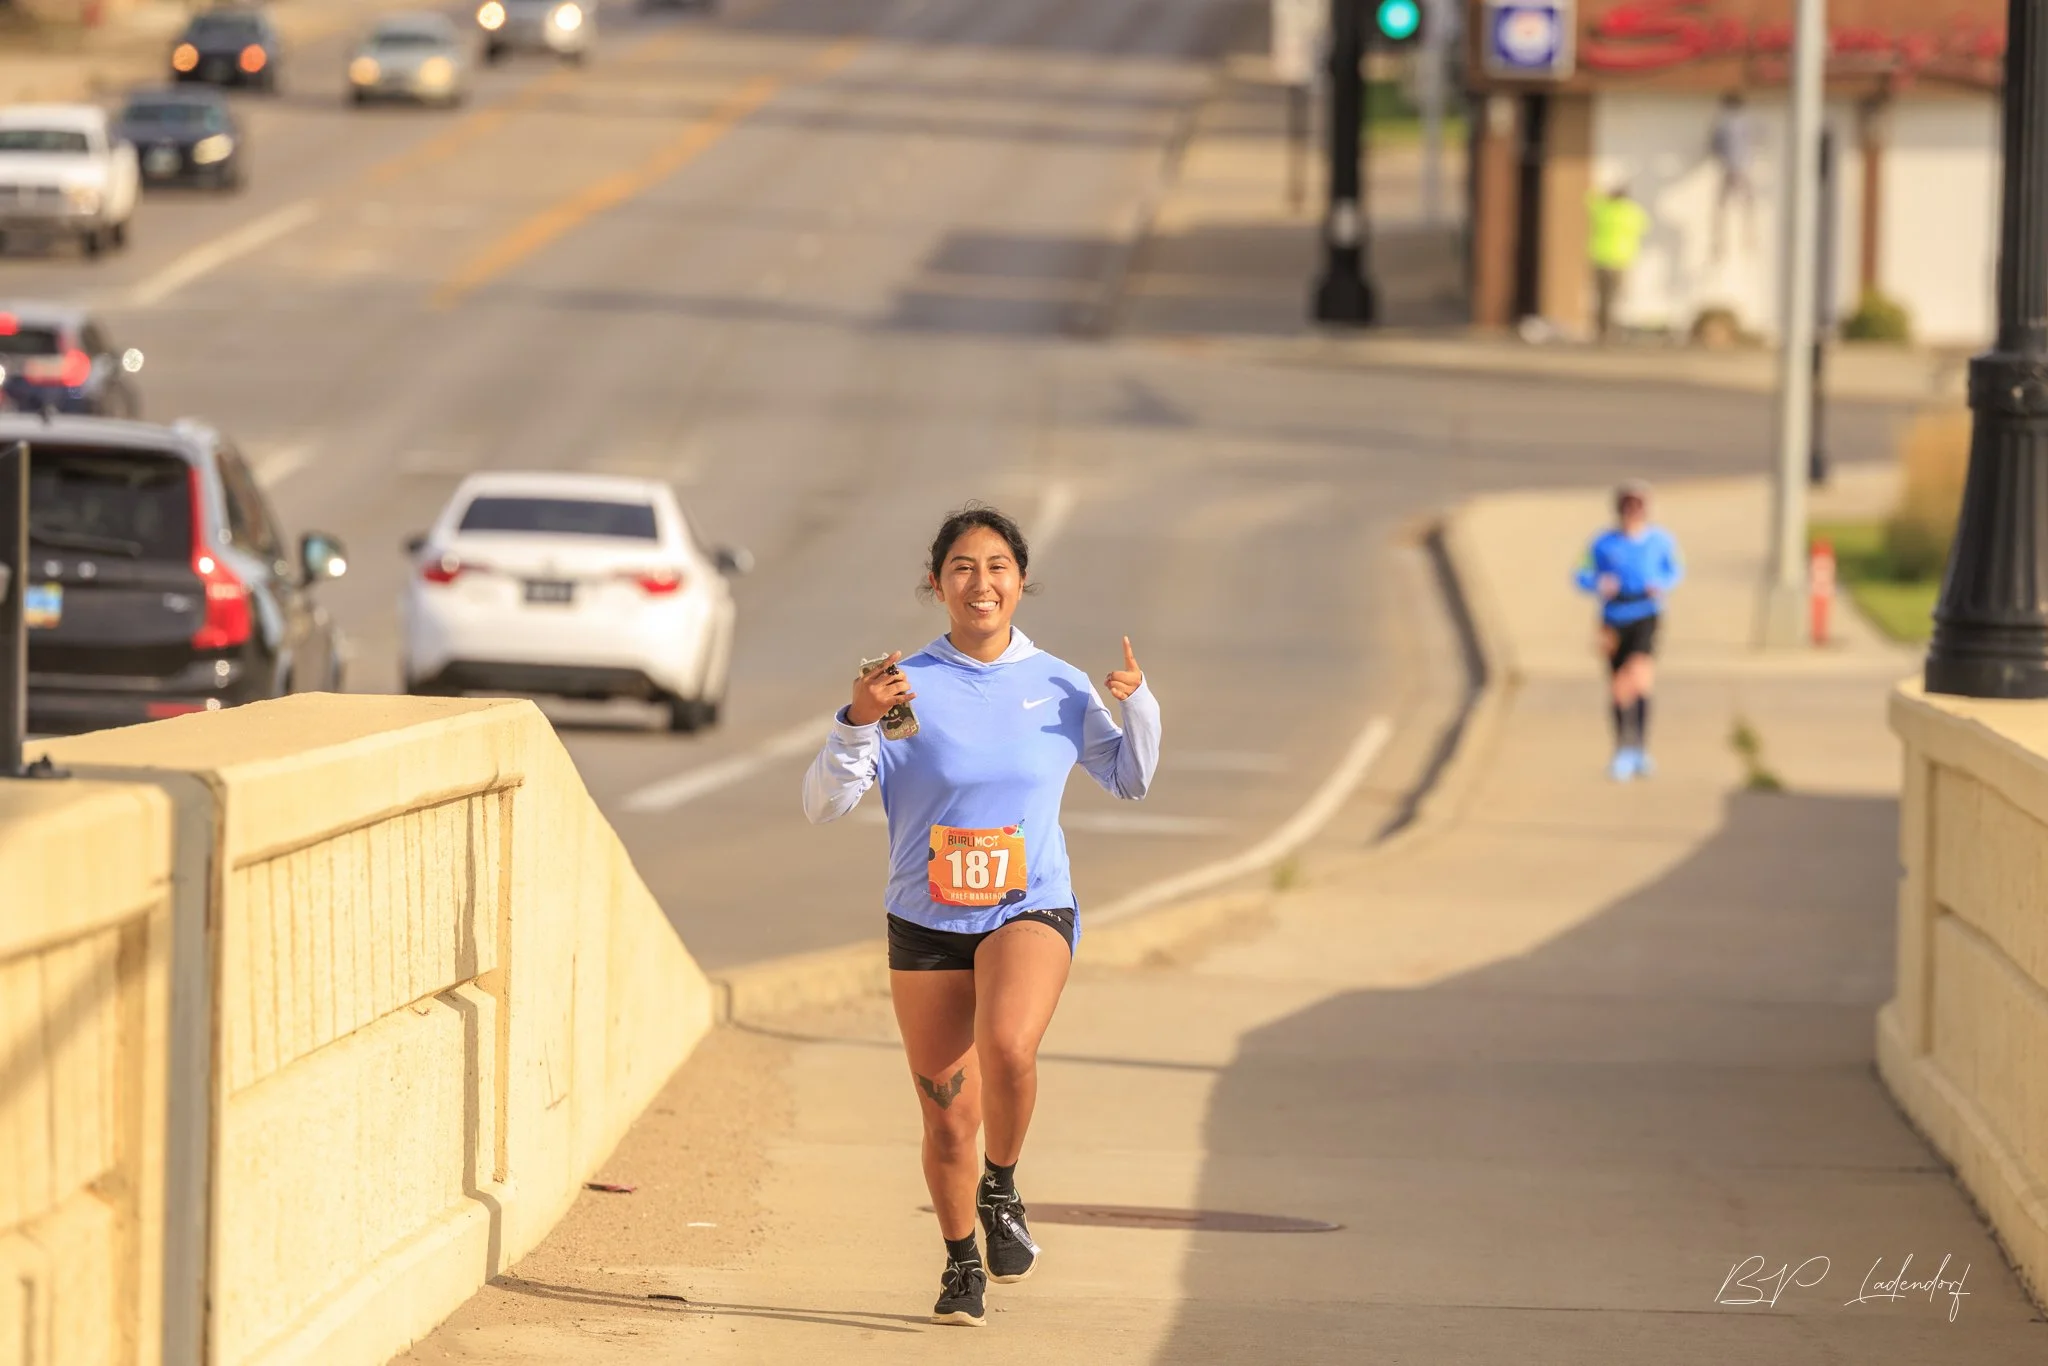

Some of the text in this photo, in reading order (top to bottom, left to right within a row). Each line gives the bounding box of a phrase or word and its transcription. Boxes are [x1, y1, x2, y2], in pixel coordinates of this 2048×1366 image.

[945, 849, 1009, 889] 187
[950, 892, 1007, 900] HALF MARATHON
